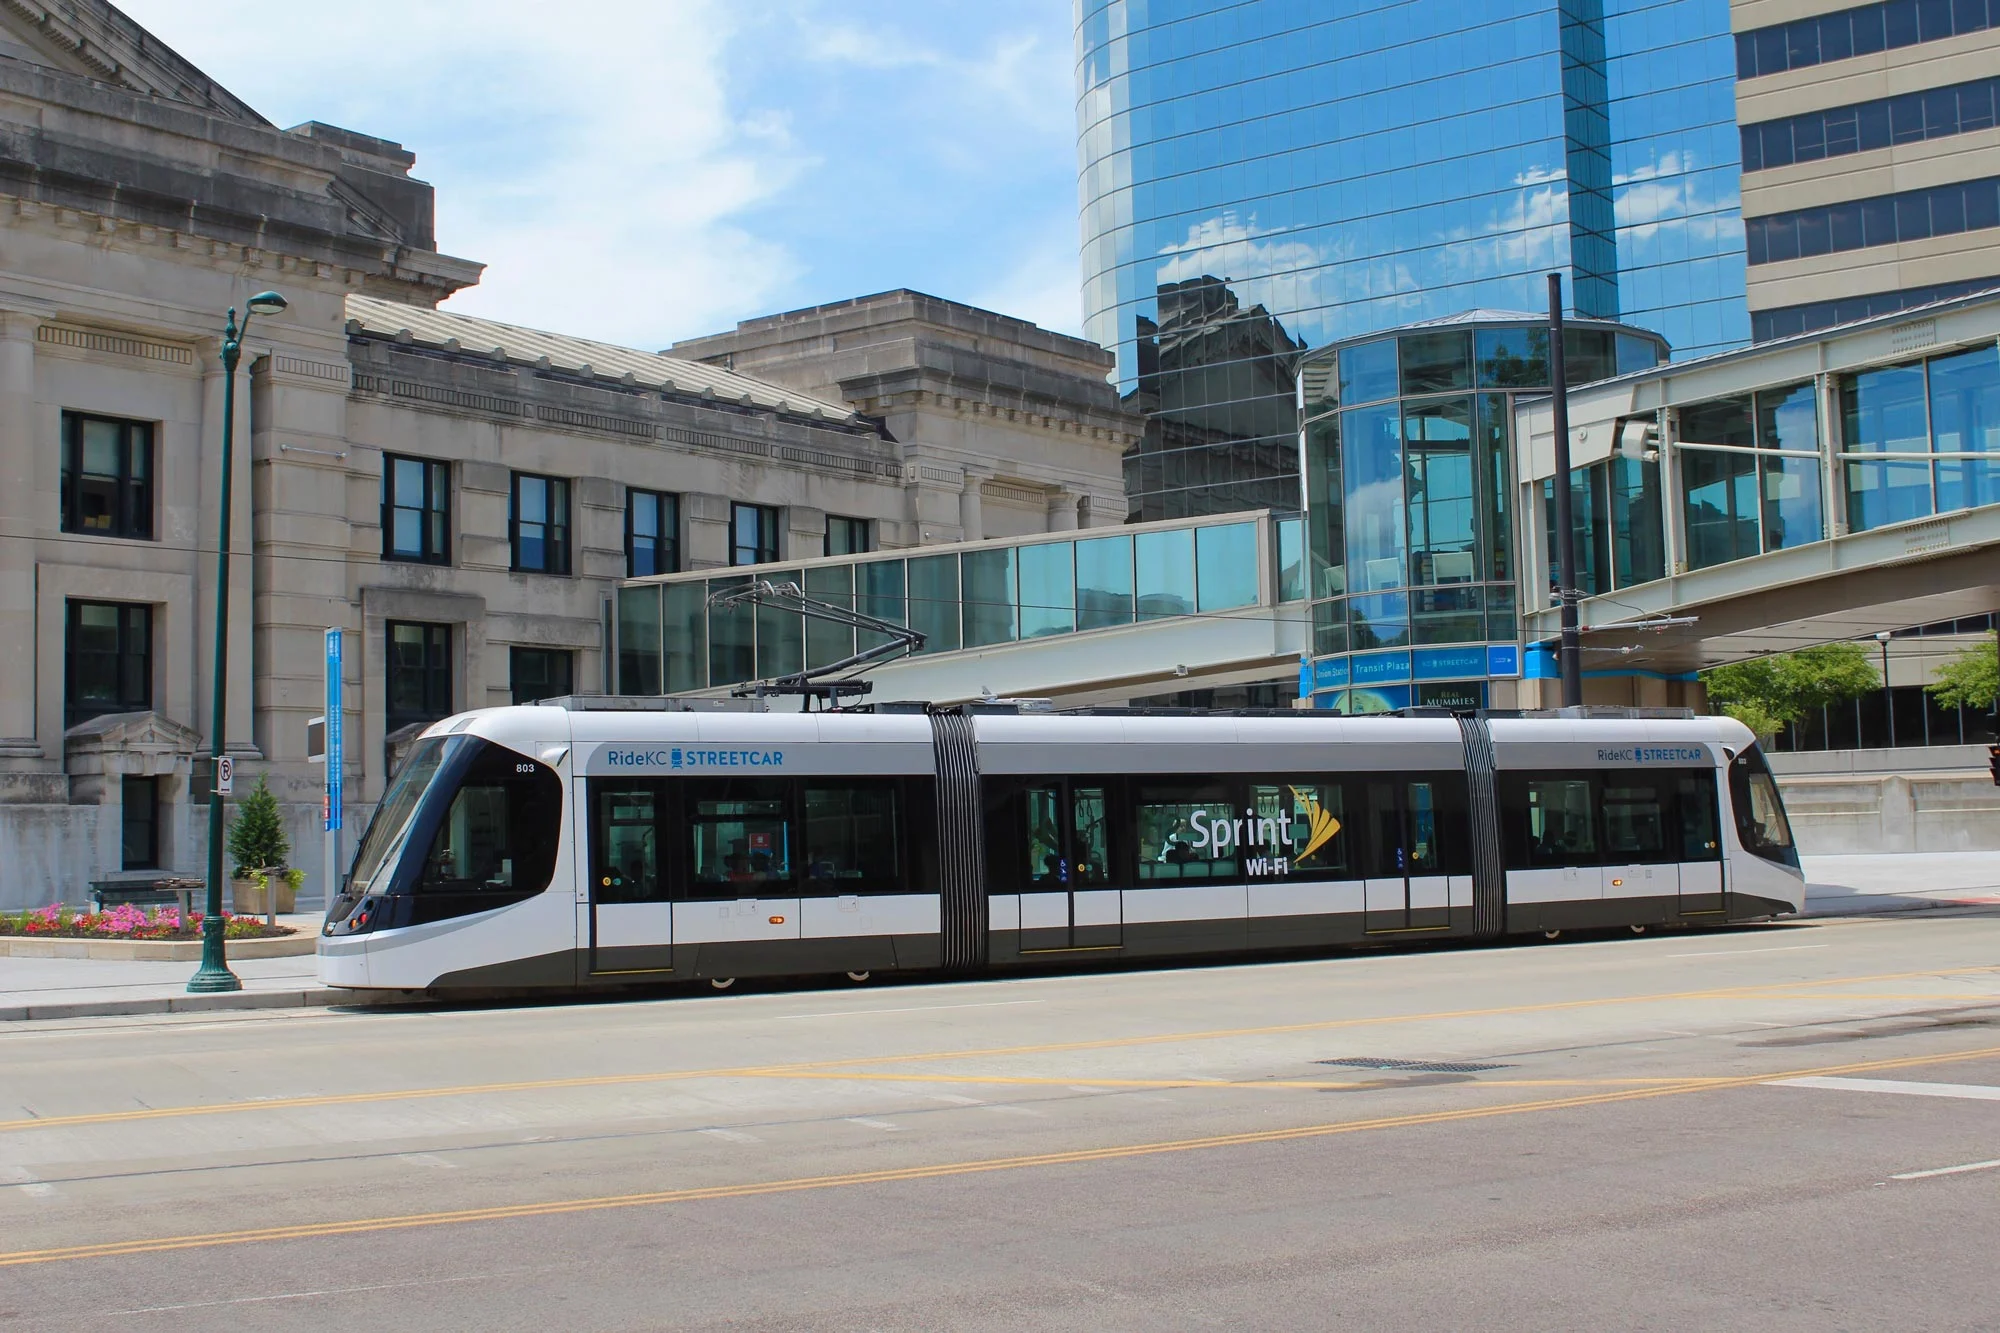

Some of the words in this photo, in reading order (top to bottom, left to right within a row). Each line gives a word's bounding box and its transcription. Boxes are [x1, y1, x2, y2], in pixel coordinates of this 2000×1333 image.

[1332, 666, 1349, 677] Statio
[1355, 663, 1384, 673] Transit
[1386, 661, 1410, 671] Plaza
[1438, 658, 1479, 667] STREETCAR
[1426, 697, 1475, 707] MUMMIES
[608, 750, 667, 766] RideKC
[686, 750, 783, 766] STREETCAR
[1597, 749, 1633, 761] RideKC
[1643, 748, 1701, 761] STREETCAR
[516, 763, 535, 773] 803
[1190, 808, 1293, 858] Sprint
[1246, 857, 1288, 876] Wi-Fi
